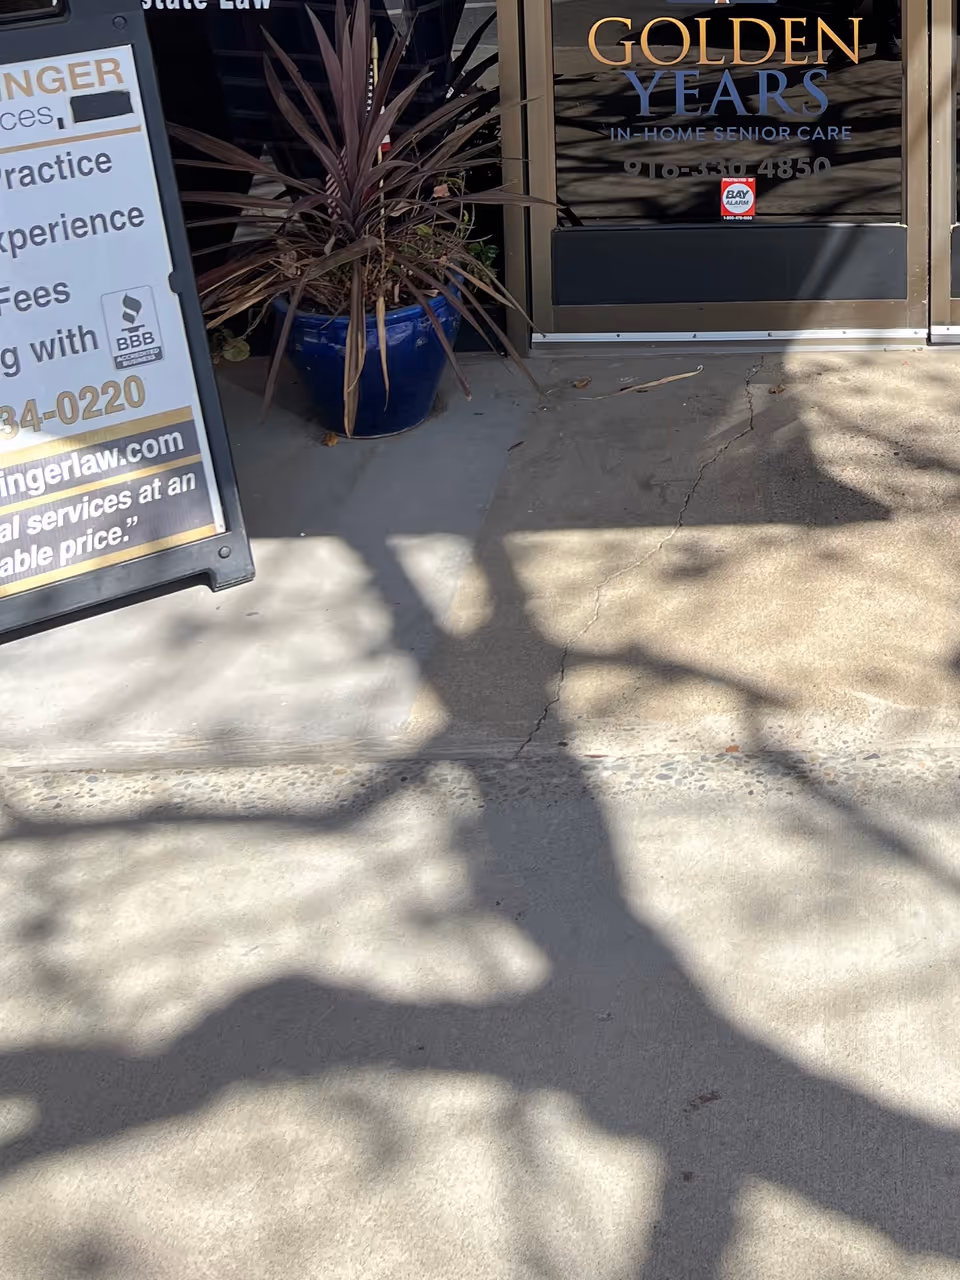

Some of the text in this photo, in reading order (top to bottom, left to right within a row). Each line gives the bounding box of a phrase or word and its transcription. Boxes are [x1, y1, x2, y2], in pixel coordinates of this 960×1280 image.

[587, 16, 863, 66] GOLDEN
[0, 57, 125, 101] NGER
[619, 68, 829, 118] YEARS
[609, 125, 852, 142] IN-HOME SENIOR CARE
[0, 151, 113, 190] ractice
[726, 189, 750, 199] BAY
[30, 325, 99, 363] with
[116, 331, 156, 352] BBB
[116, 348, 160, 363] ACCREDITED
[27, 490, 132, 535] services
[138, 477, 161, 504] at
[167, 472, 196, 496] an
